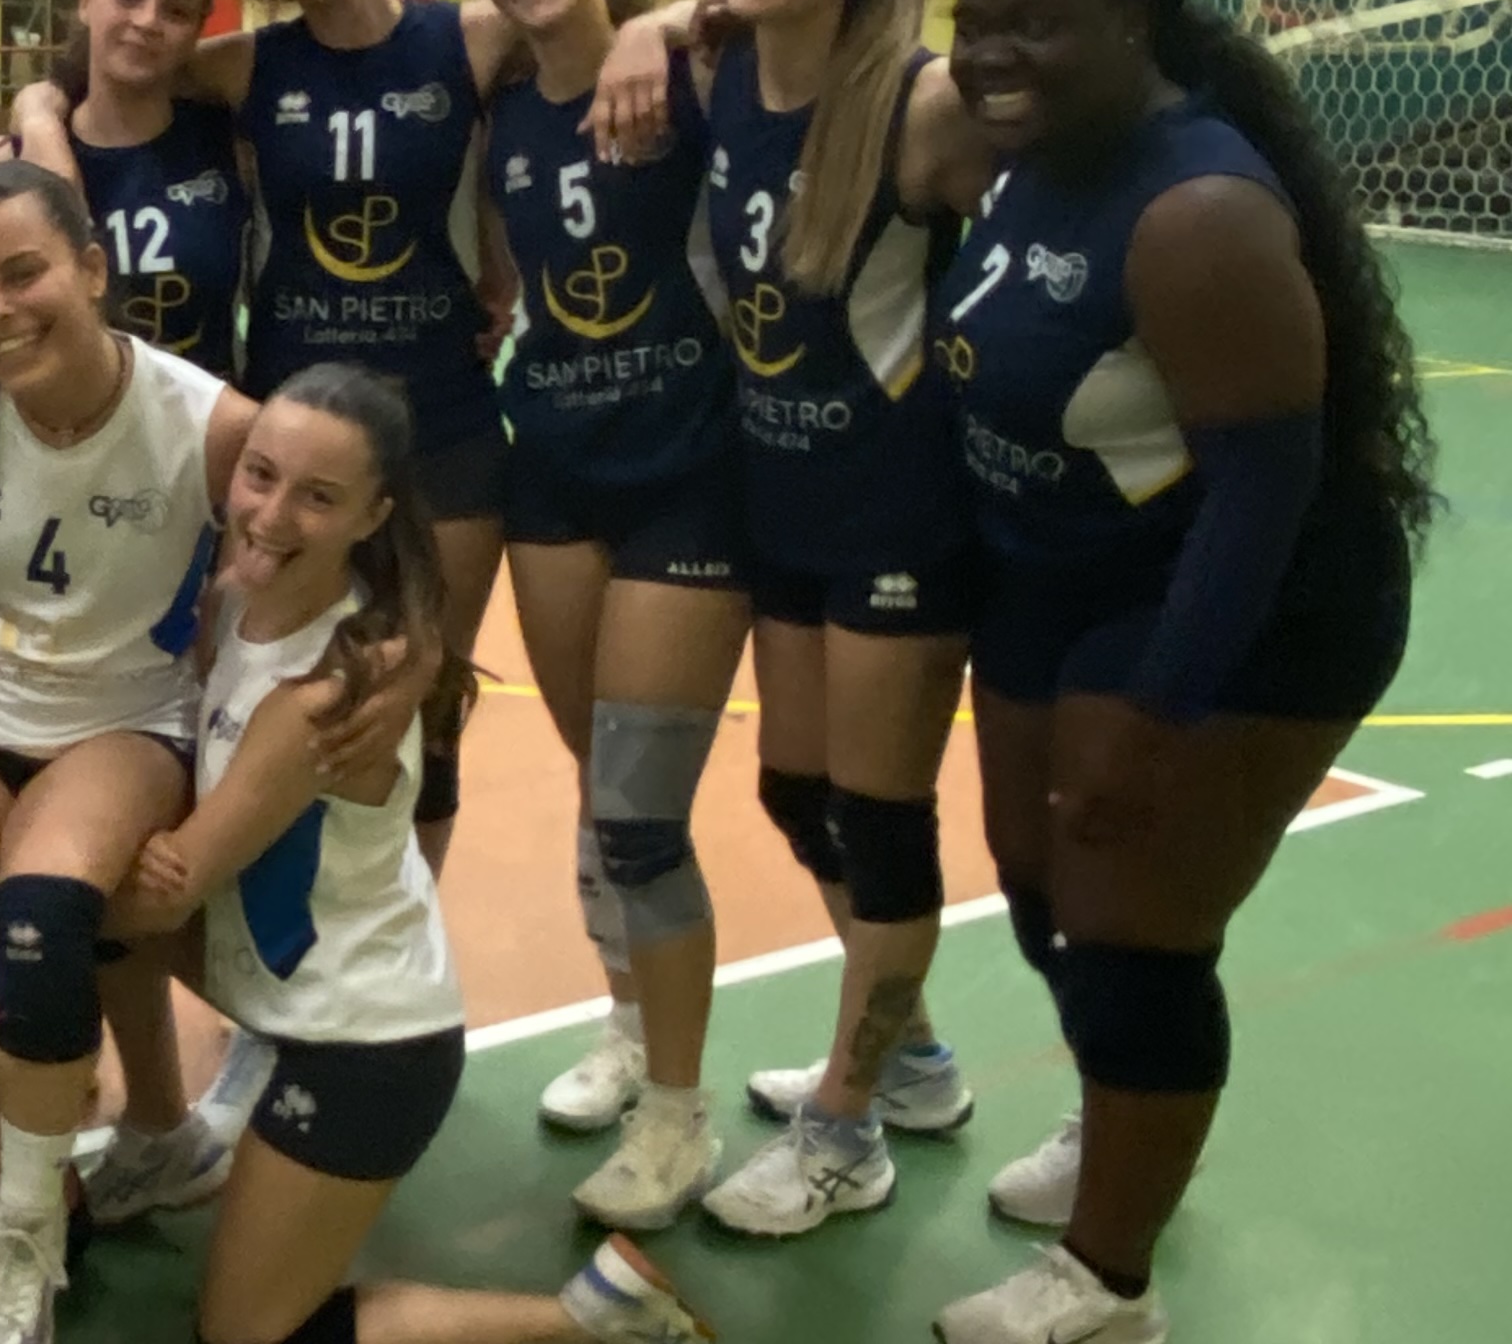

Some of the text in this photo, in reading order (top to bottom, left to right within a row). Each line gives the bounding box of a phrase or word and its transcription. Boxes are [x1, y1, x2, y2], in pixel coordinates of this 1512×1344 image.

[328, 109, 375, 181] 11
[558, 160, 596, 239] 5
[740, 190, 775, 273] 3
[106, 205, 175, 275] 12
[274, 292, 452, 323] SAN PIETRO
[949, 243, 1011, 323] 7
[525, 362, 577, 391] SAN
[584, 337, 703, 385] PIETRO
[27, 517, 71, 595] 4
